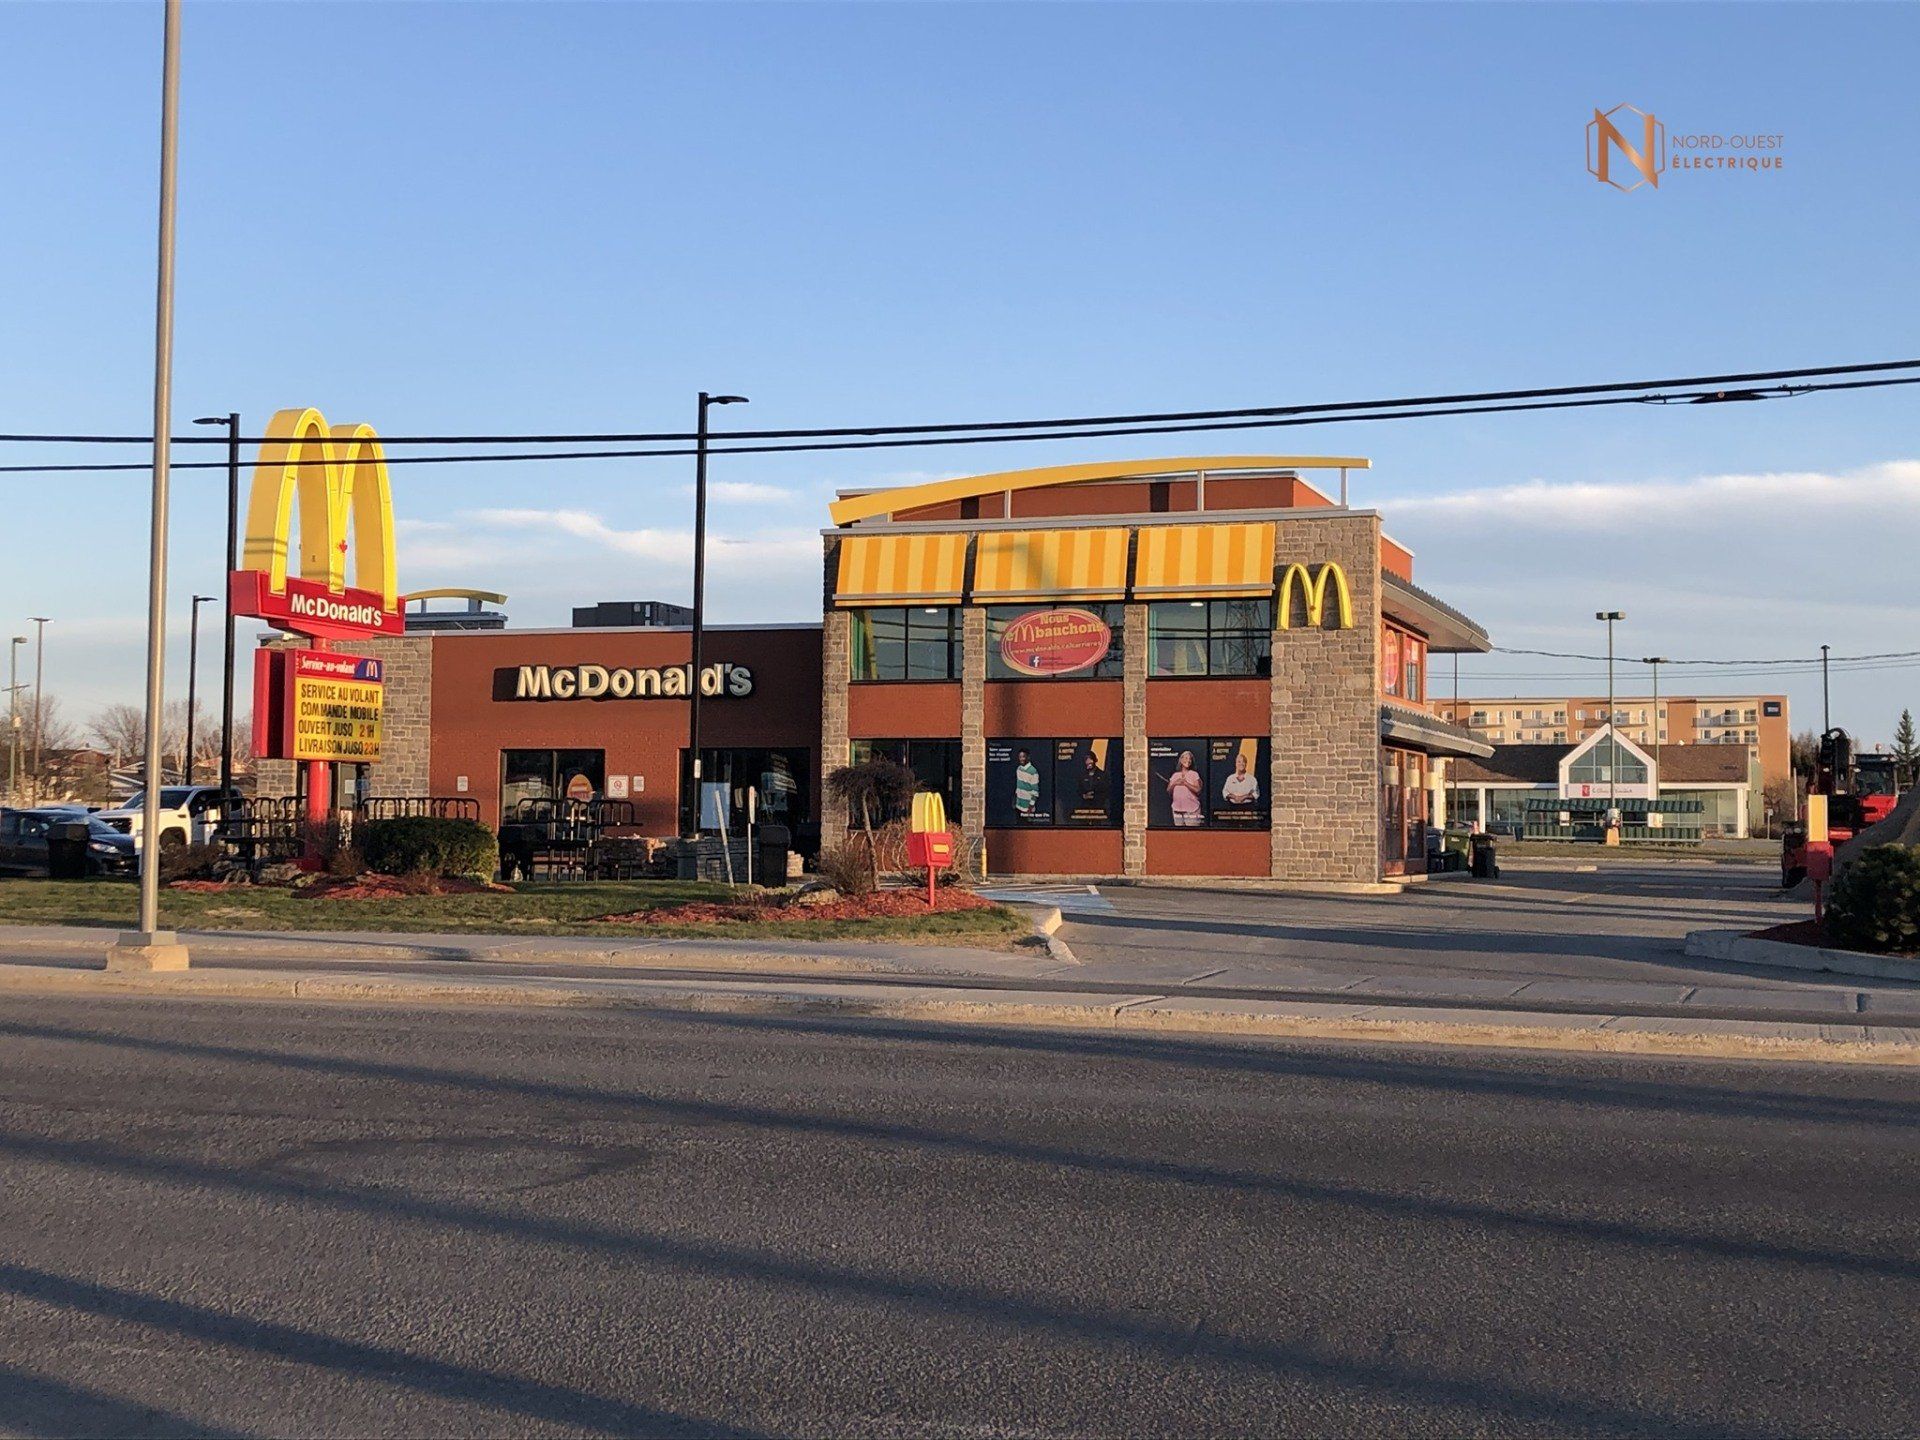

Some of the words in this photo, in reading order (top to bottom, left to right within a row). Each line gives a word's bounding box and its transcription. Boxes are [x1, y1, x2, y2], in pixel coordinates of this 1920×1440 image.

[291, 593, 383, 627] McDonald's
[1039, 615, 1069, 625] Nous
[516, 662, 752, 698] McDonald's
[301, 683, 336, 700] SERVICE
[337, 687, 349, 701] AU
[350, 689, 380, 704] VOLANT
[301, 701, 348, 719] COMMANDE
[349, 705, 379, 721] MOBILE
[298, 719, 332, 736] OUVERT
[333, 721, 354, 737] JUSQ
[299, 738, 343, 754] LIVRAISON
